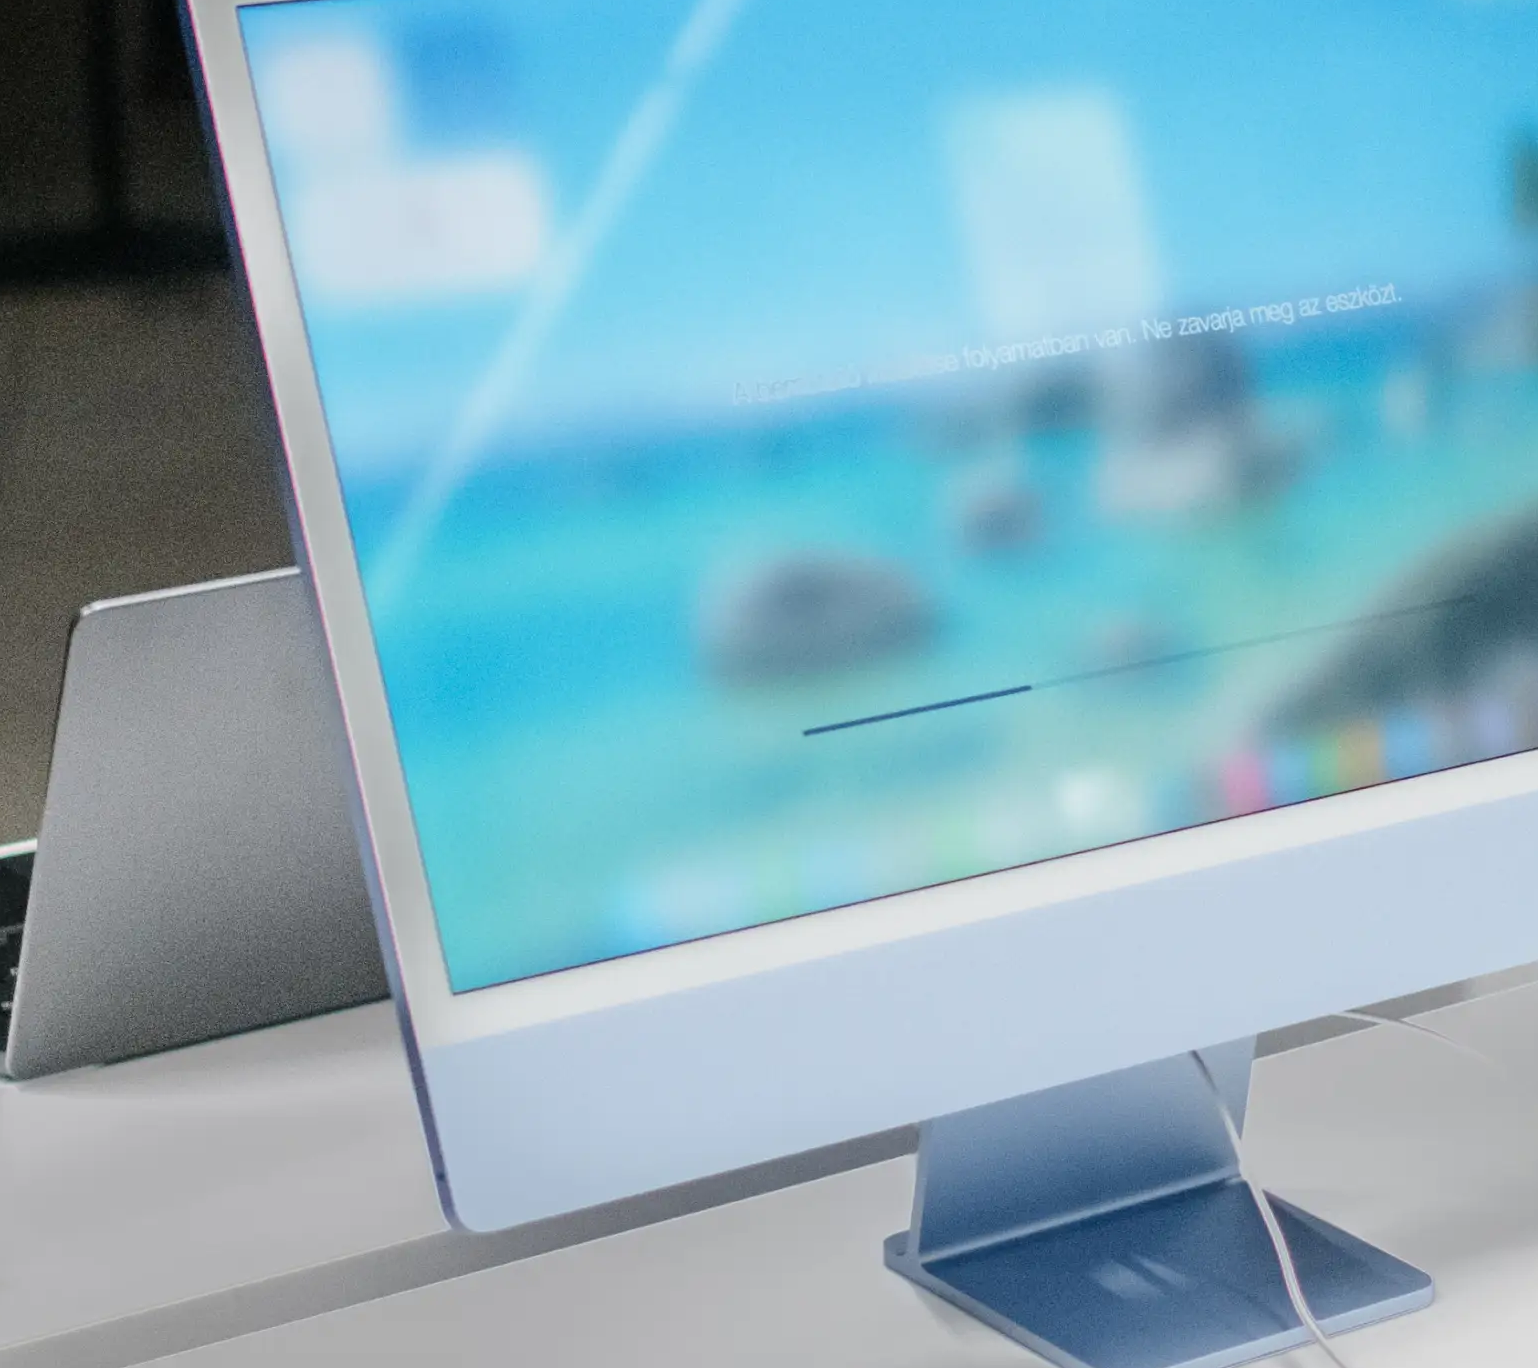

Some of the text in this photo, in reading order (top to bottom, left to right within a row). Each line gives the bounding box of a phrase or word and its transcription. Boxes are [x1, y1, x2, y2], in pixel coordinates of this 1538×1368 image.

[1094, 325, 1136, 349] van.
[1141, 318, 1173, 341] Ne
[1177, 309, 1245, 337] zavarja
[1249, 301, 1294, 326] meg
[1298, 297, 1322, 317] az
[1326, 283, 1403, 313] eszközt.
